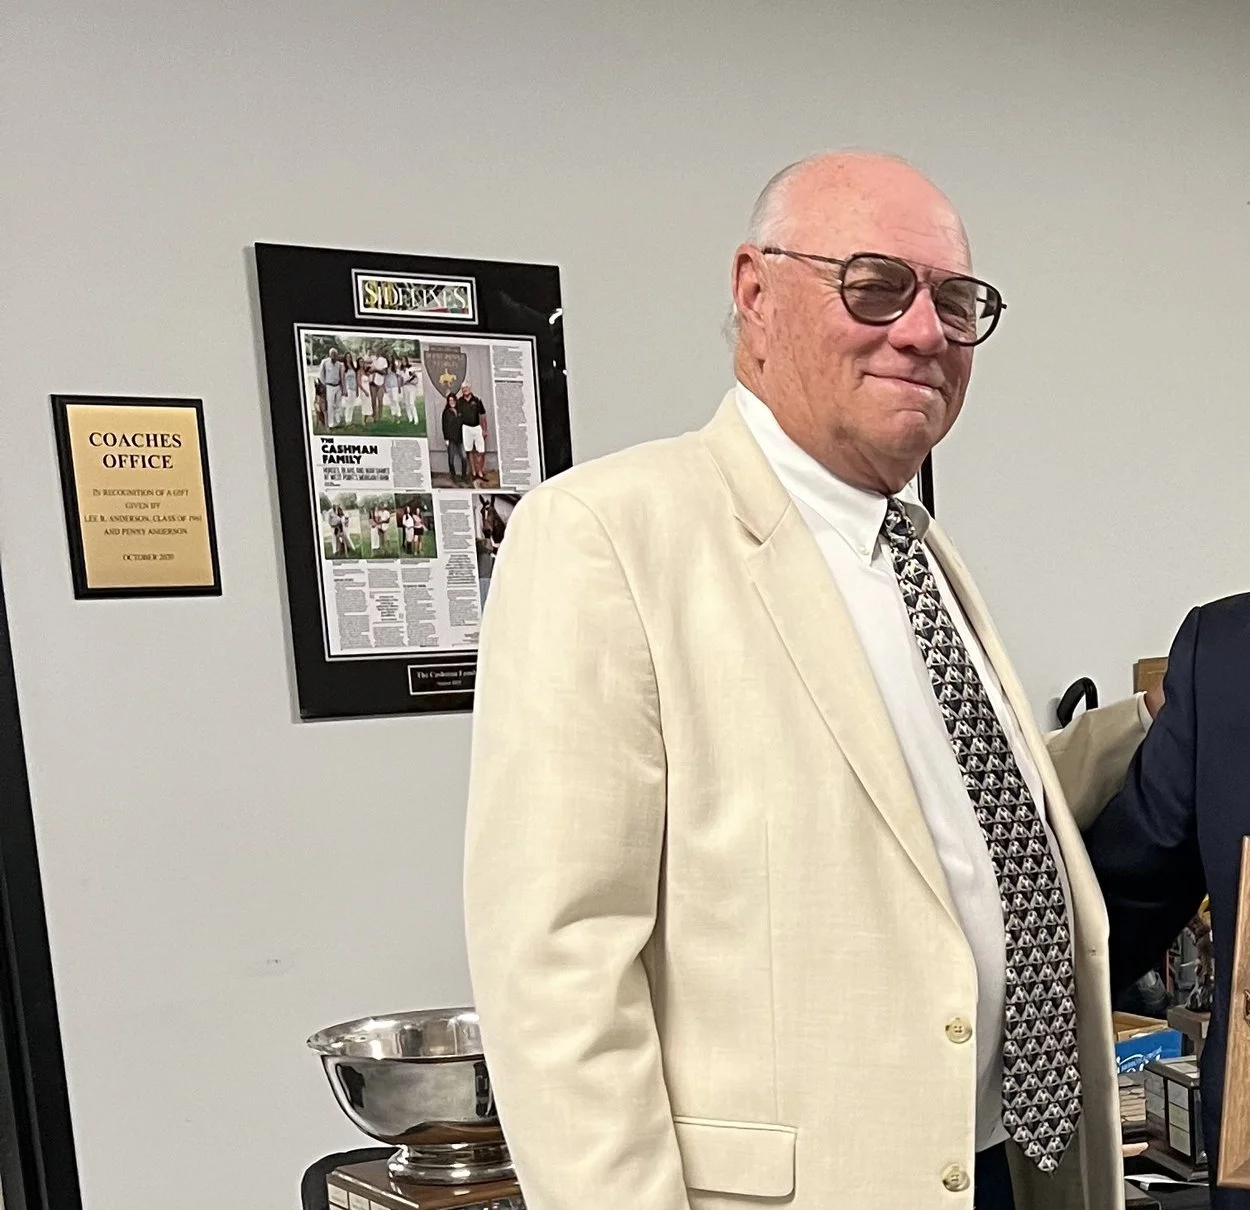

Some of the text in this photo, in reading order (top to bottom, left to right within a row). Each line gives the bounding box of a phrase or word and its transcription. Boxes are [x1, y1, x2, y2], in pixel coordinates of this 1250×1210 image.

[89, 431, 182, 448] COACHES
[321, 444, 378, 455] CASHMAN
[102, 454, 174, 469] OFFICE
[322, 454, 362, 465] FAMILY
